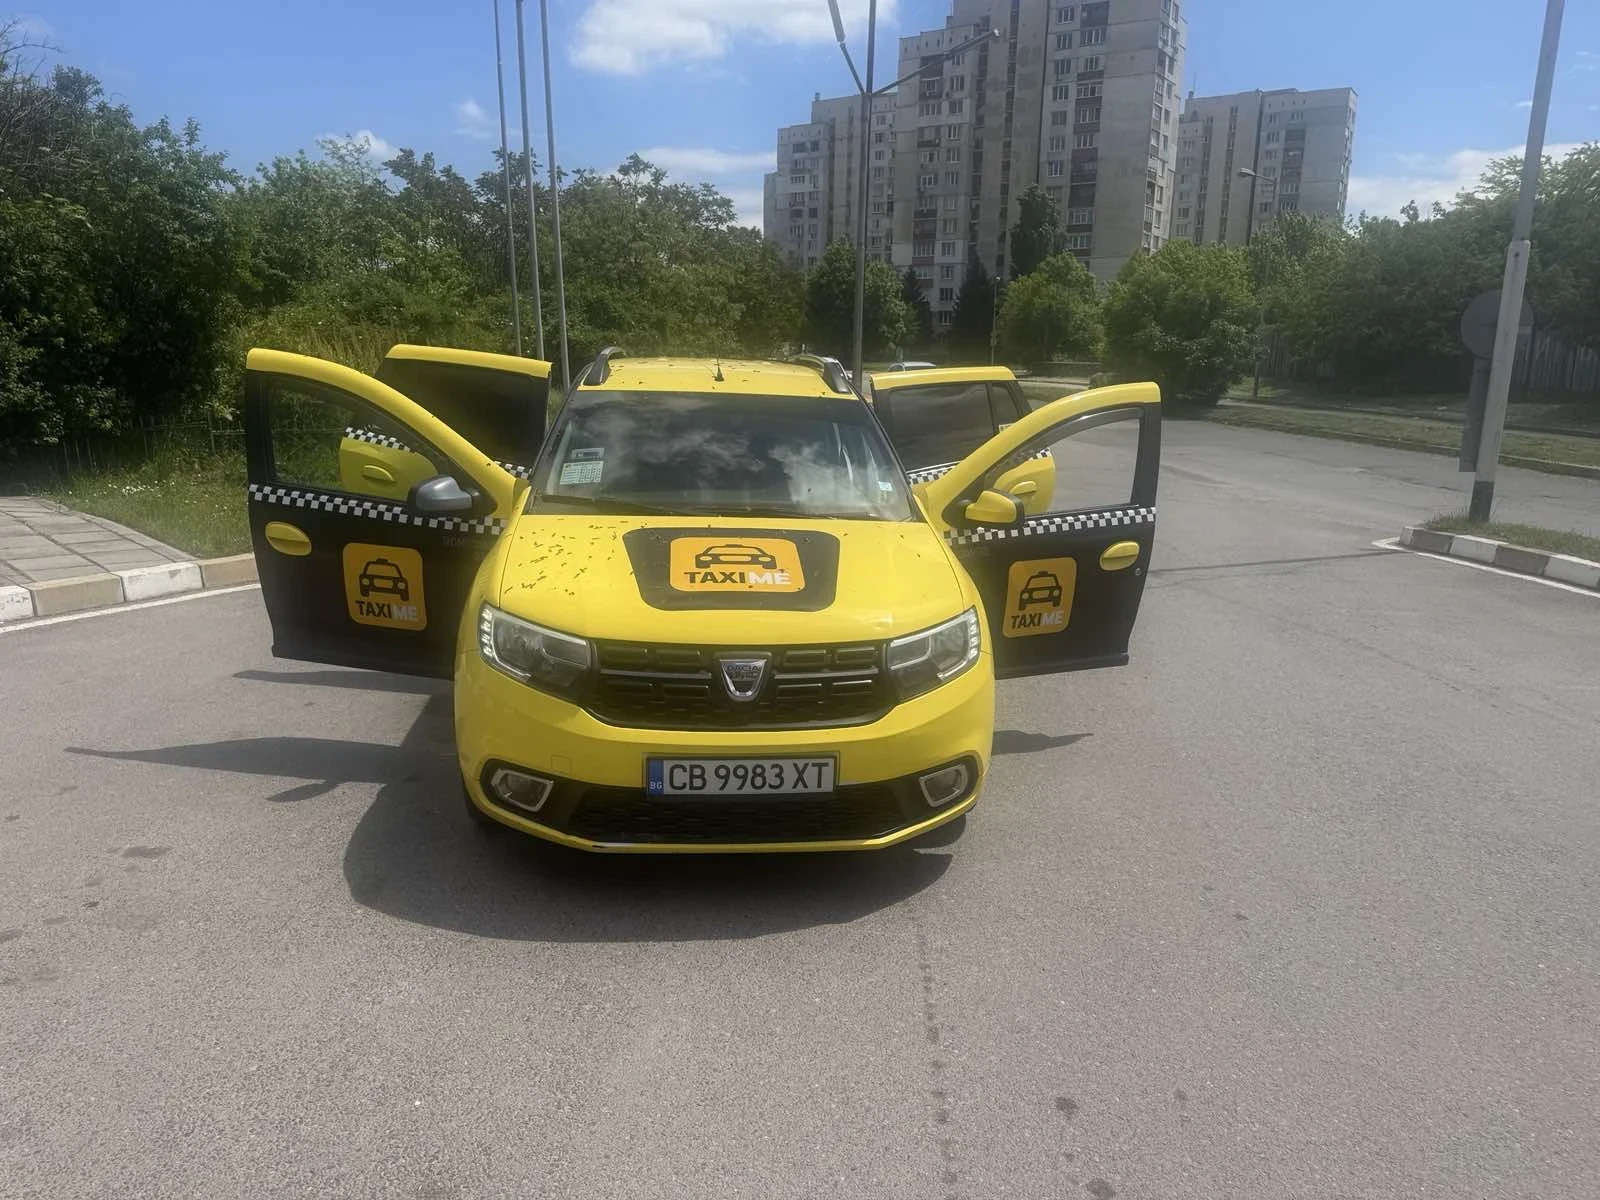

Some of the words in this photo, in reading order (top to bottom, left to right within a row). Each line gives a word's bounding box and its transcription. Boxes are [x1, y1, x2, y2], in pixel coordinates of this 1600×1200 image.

[669, 763, 707, 790] CB
[714, 763, 784, 790] 9983
[792, 762, 829, 789] XT
